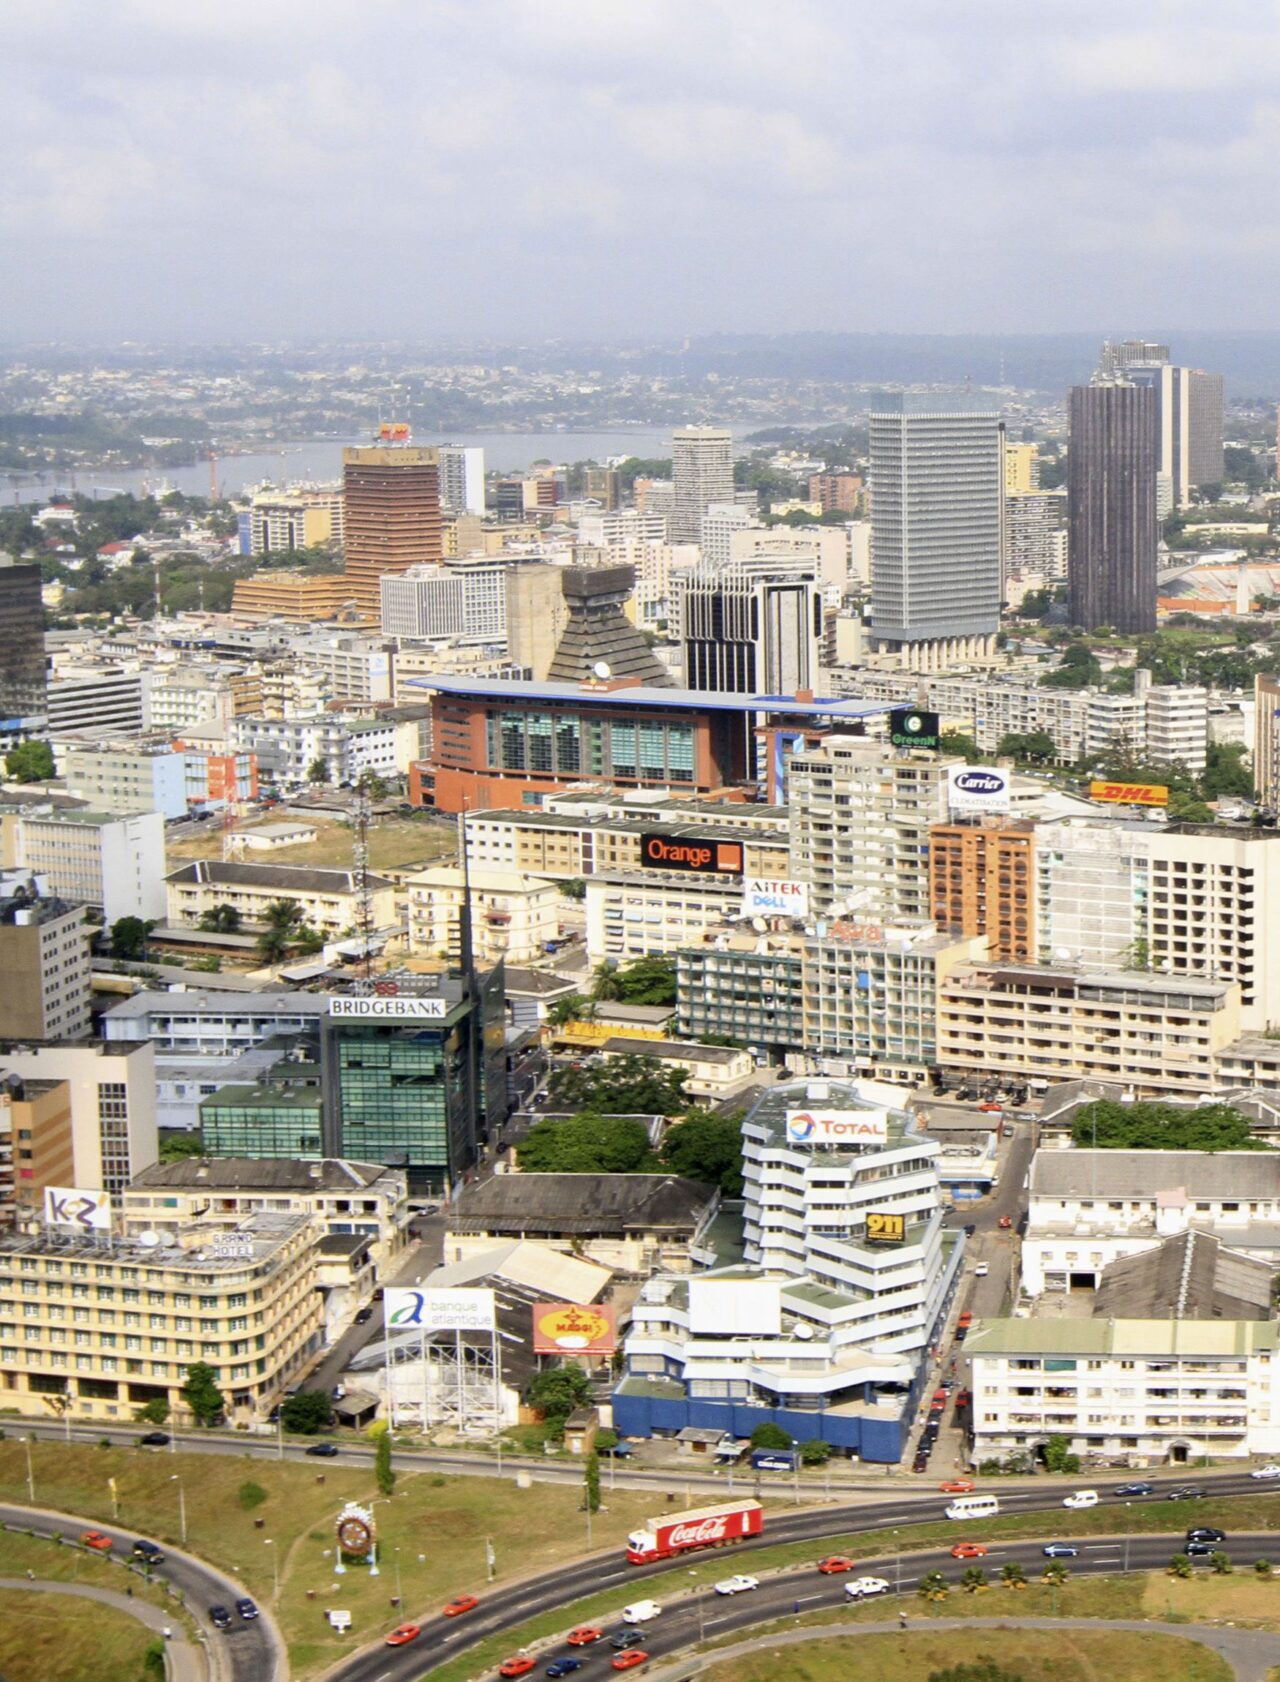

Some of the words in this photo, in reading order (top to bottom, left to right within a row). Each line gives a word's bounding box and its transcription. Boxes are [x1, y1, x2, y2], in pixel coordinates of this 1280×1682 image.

[957, 774, 1002, 789] Carrier
[1104, 786, 1154, 801] DHL
[648, 839, 712, 868] Orange
[750, 882, 802, 895] AiTEK
[753, 895, 787, 908] DELL
[333, 1001, 441, 1015] BRIDGEBANK
[820, 1120, 885, 1136] TOTAL
[866, 1214, 904, 1234] 911
[213, 1234, 253, 1243] GRAND
[213, 1247, 252, 1256] HOTEL
[430, 1301, 478, 1313] banque
[431, 1314, 492, 1327] atlantique
[556, 1323, 593, 1332] MAGGI
